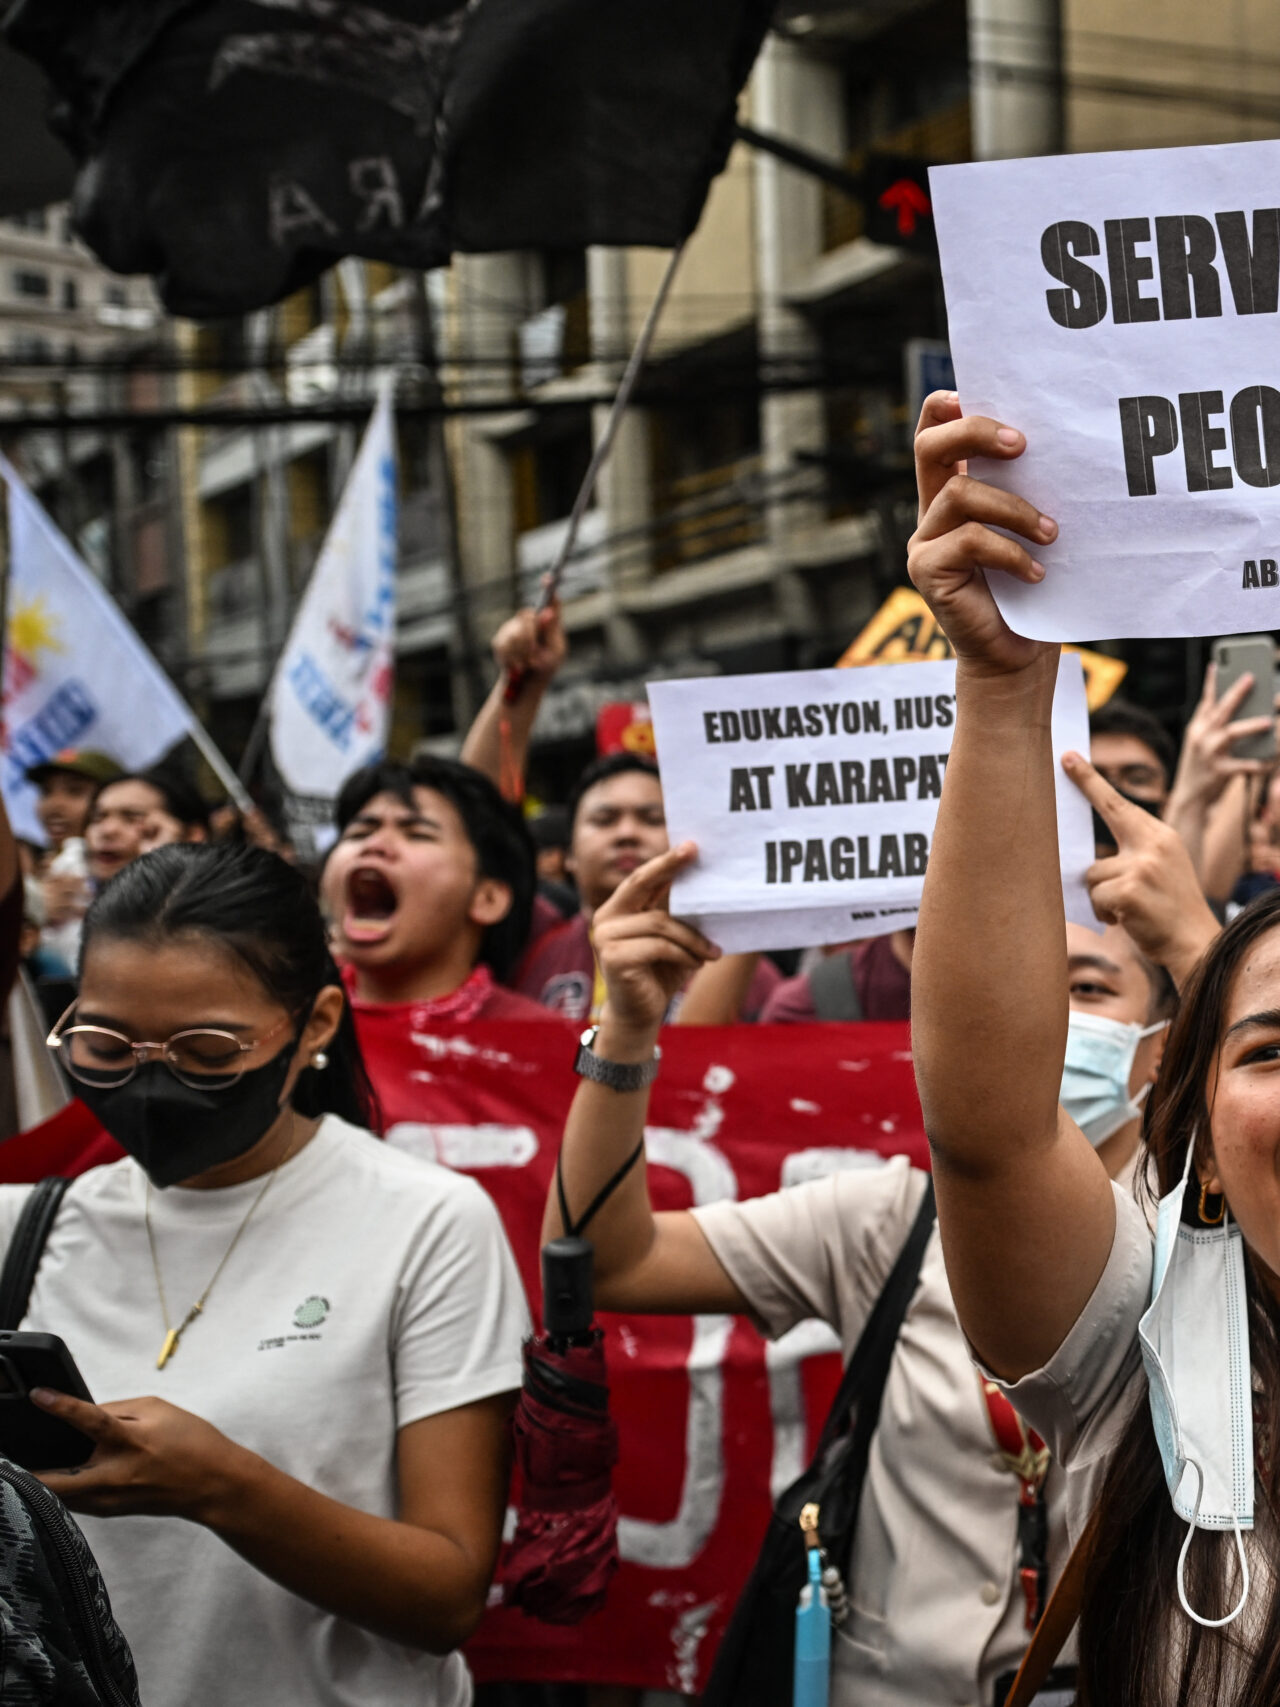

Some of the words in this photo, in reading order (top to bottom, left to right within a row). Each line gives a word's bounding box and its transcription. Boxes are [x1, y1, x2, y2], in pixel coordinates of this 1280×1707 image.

[1242, 559, 1279, 590] AB
[703, 700, 889, 744] EDUKASYON,
[894, 694, 957, 731] HUS
[729, 766, 775, 813] AT
